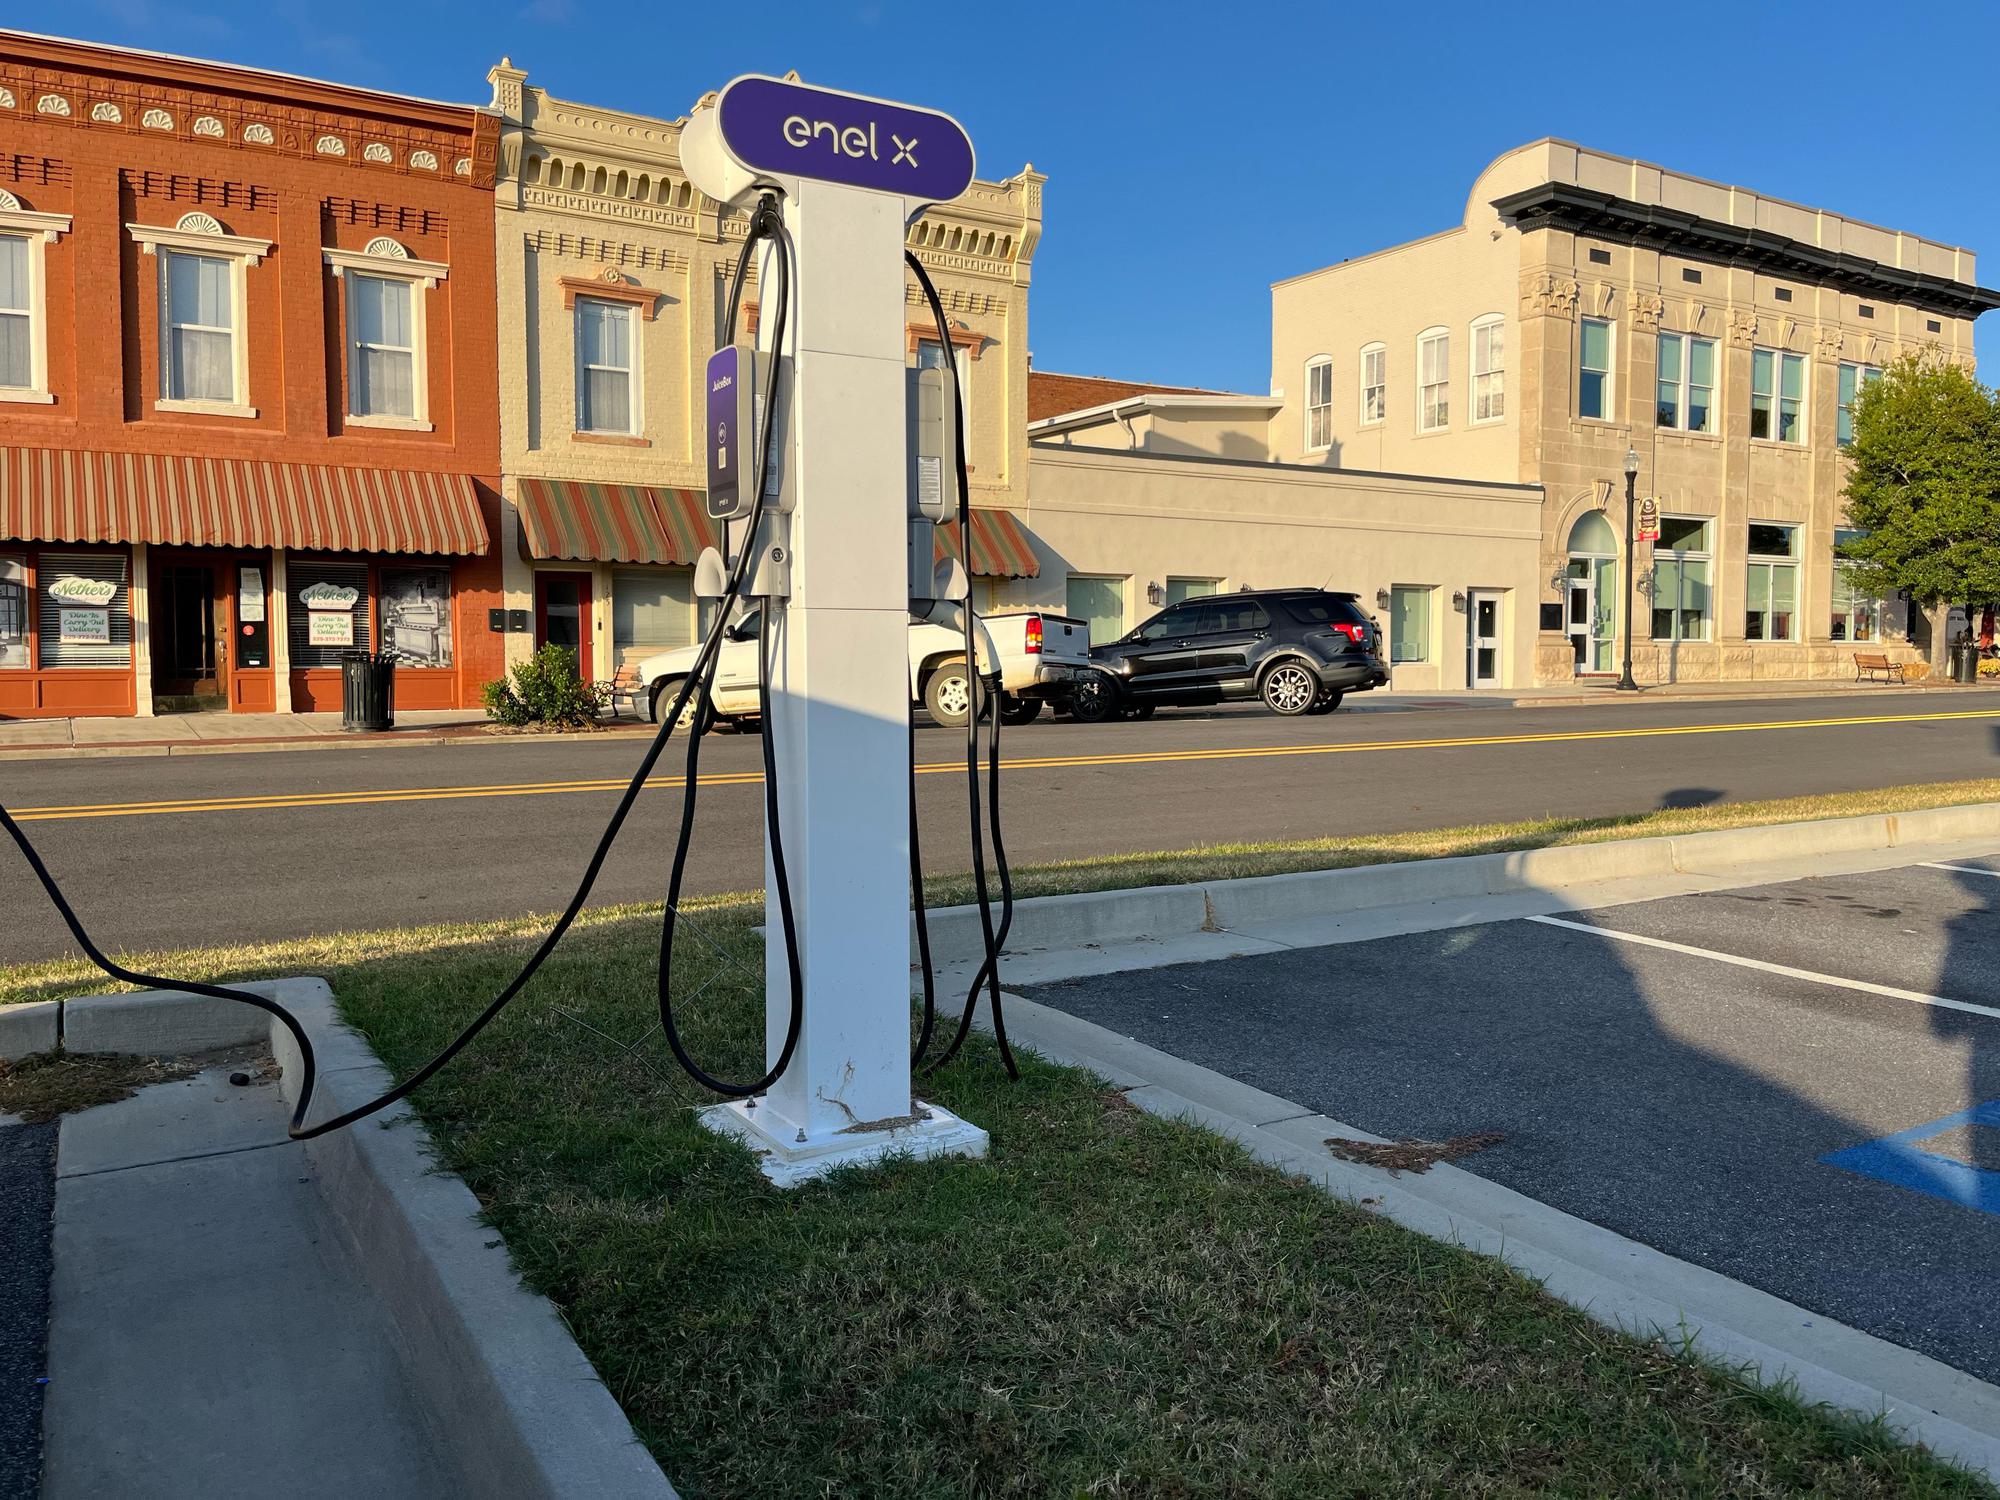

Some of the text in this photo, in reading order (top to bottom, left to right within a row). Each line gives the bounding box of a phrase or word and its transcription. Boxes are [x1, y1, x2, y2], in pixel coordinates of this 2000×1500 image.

[783, 116, 918, 168] enel x
[54, 580, 111, 596] Nether's
[303, 586, 353, 601] Nether's
[68, 626, 101, 634] Delivery
